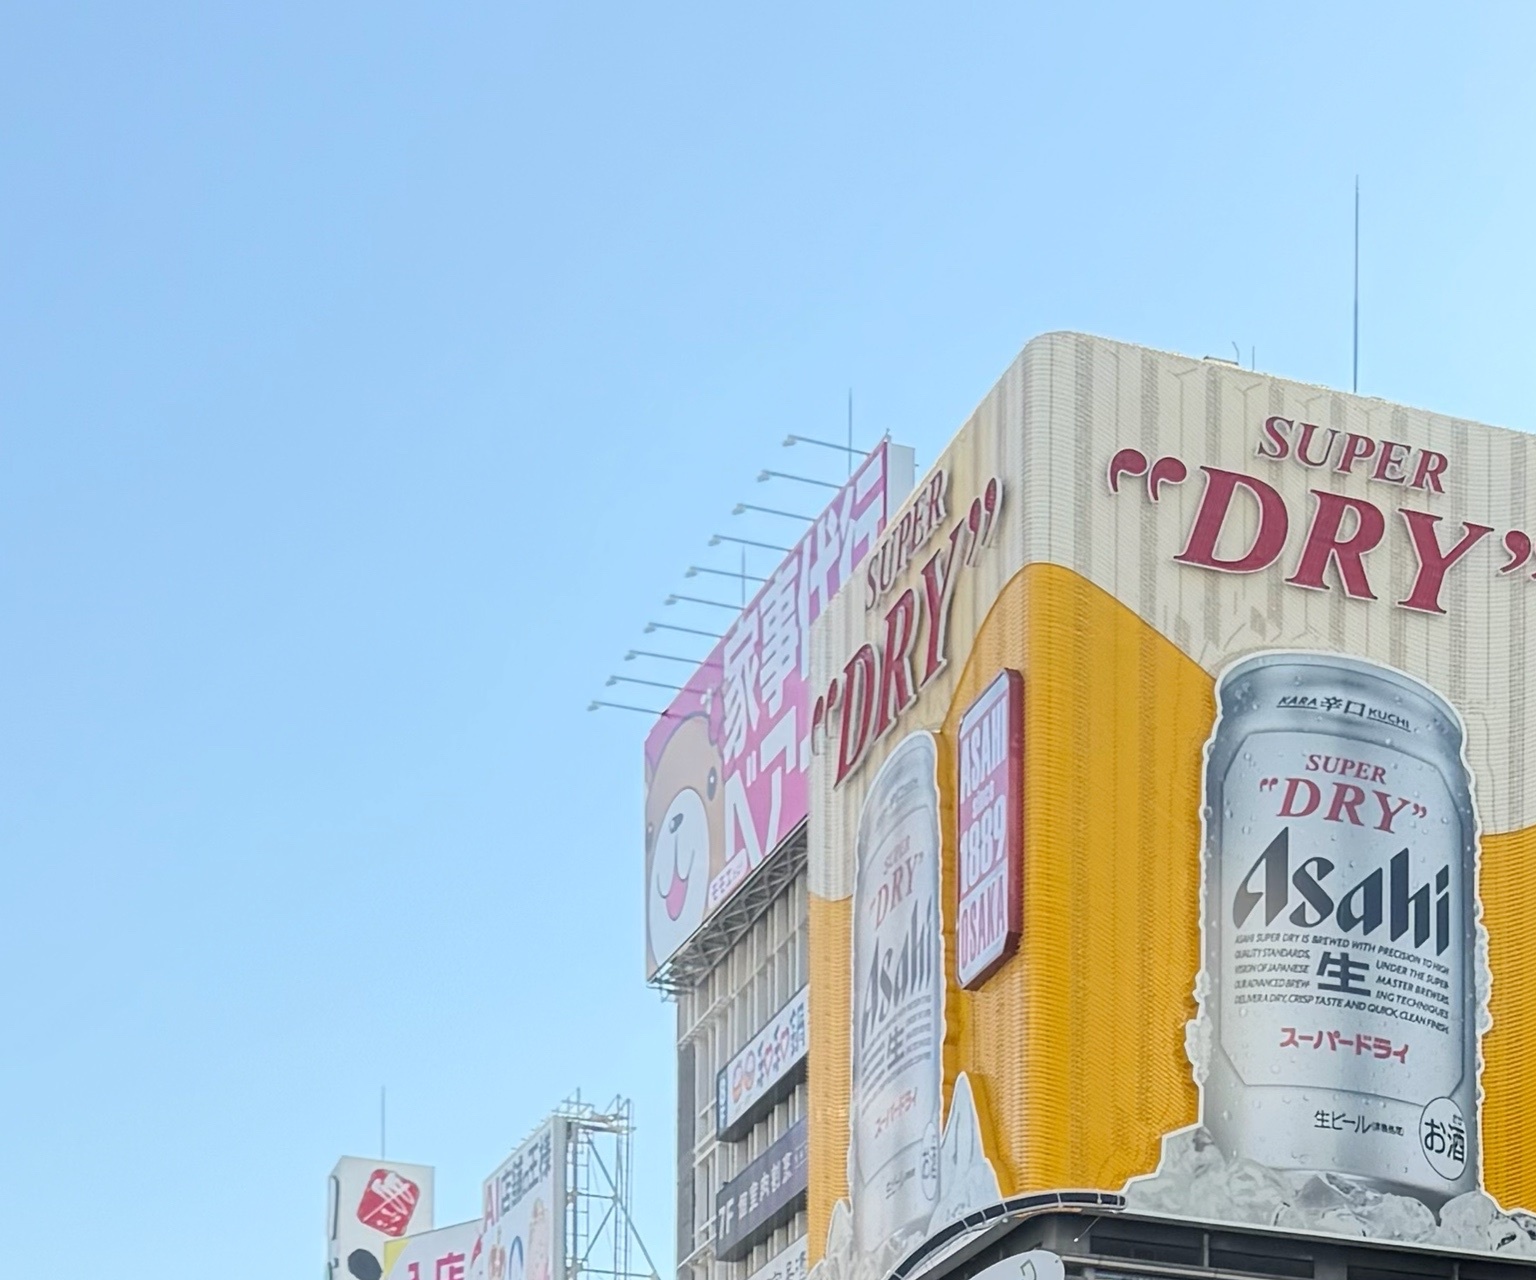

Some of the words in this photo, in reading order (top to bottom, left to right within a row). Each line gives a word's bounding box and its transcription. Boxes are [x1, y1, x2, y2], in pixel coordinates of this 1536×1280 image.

[1257, 415, 1449, 495] SUPER
[866, 468, 949, 609] SUPER
[723, 453, 886, 765] 家事代行
[1277, 695, 1318, 708] KARA
[1320, 696, 1366, 718] 辛口
[1367, 707, 1411, 730] KUCHI
[960, 694, 1009, 799] ASAHI
[1305, 753, 1387, 785] SUPER
[959, 794, 1008, 892] 1889
[1232, 826, 1450, 957] Asahi
[958, 872, 1007, 971] OSAKA
[861, 894, 933, 1049] Asahi
[1282, 933, 1300, 943] DRY
[1311, 935, 1350, 948] BREWED
[1352, 940, 1376, 952] WITH
[1378, 945, 1421, 964] PRECISION
[1376, 959, 1408, 975] UNDER
[1409, 968, 1425, 980] THE
[1315, 950, 1372, 997] 生
[1375, 975, 1414, 991] MASTER
[1376, 990, 1395, 1002] ING
[1315, 996, 1343, 1008] TASTE
[1344, 1000, 1367, 1011] AND
[1400, 1011, 1426, 1025] CLEAN
[1279, 1026, 1409, 1064] スーパードライ
